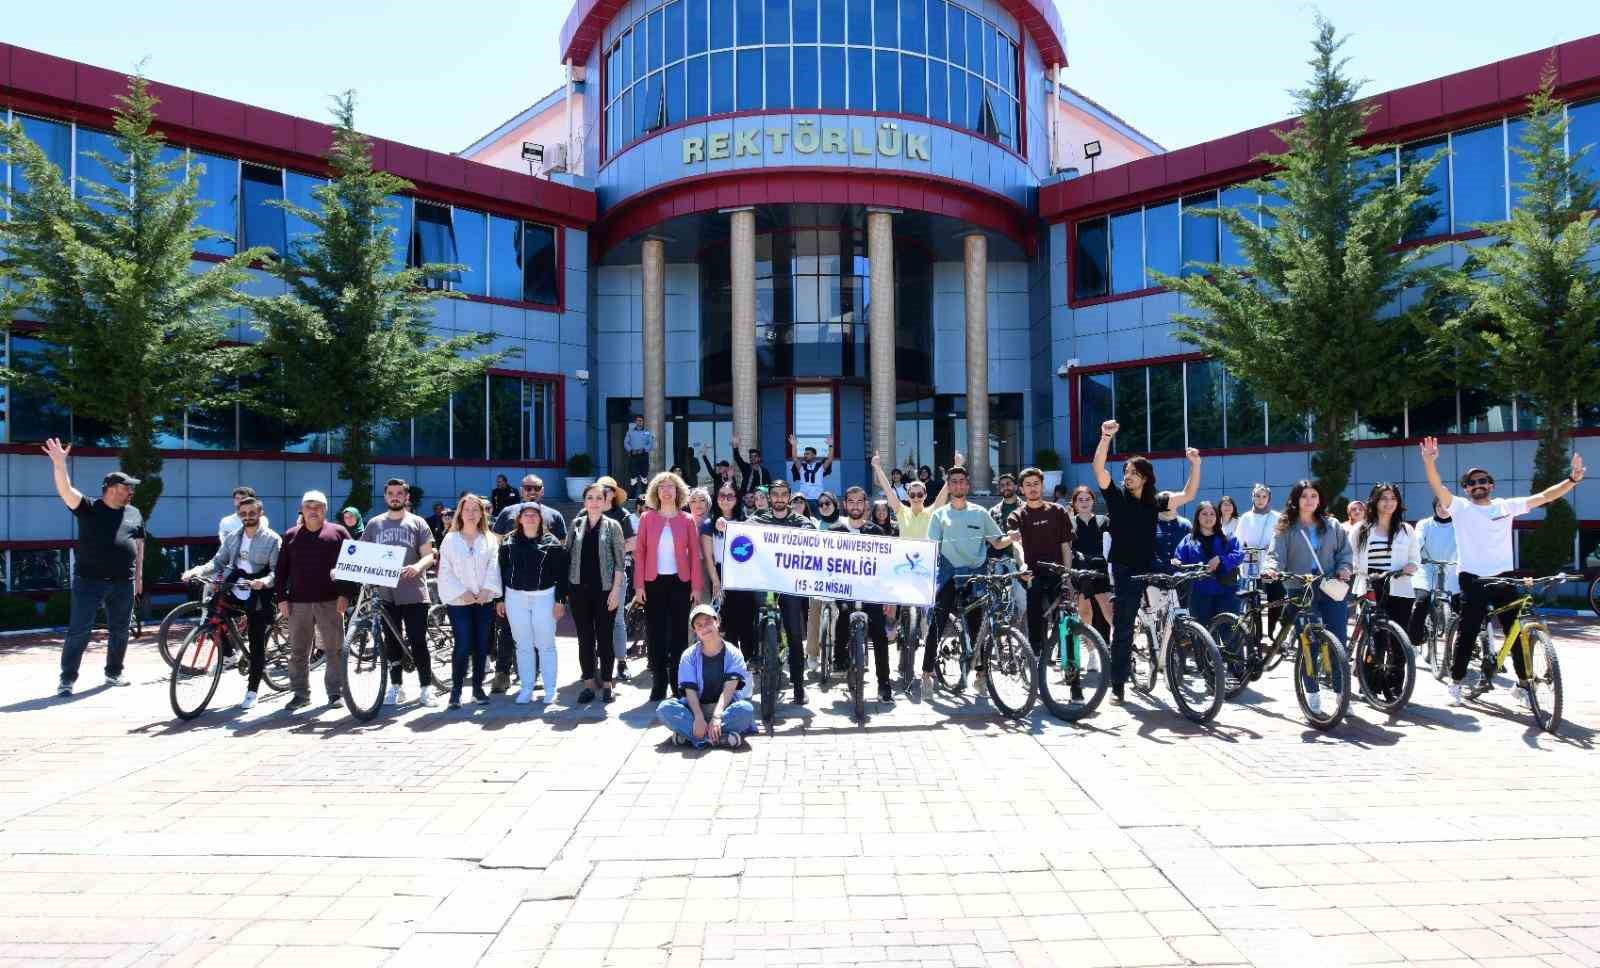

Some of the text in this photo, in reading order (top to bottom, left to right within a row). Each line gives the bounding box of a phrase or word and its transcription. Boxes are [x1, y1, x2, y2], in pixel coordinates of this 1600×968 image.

[682, 119, 930, 164] REKTÖRLÜK
[763, 531, 780, 544] VAN
[775, 550, 823, 571] TURİZM
[814, 580, 824, 592] 22
